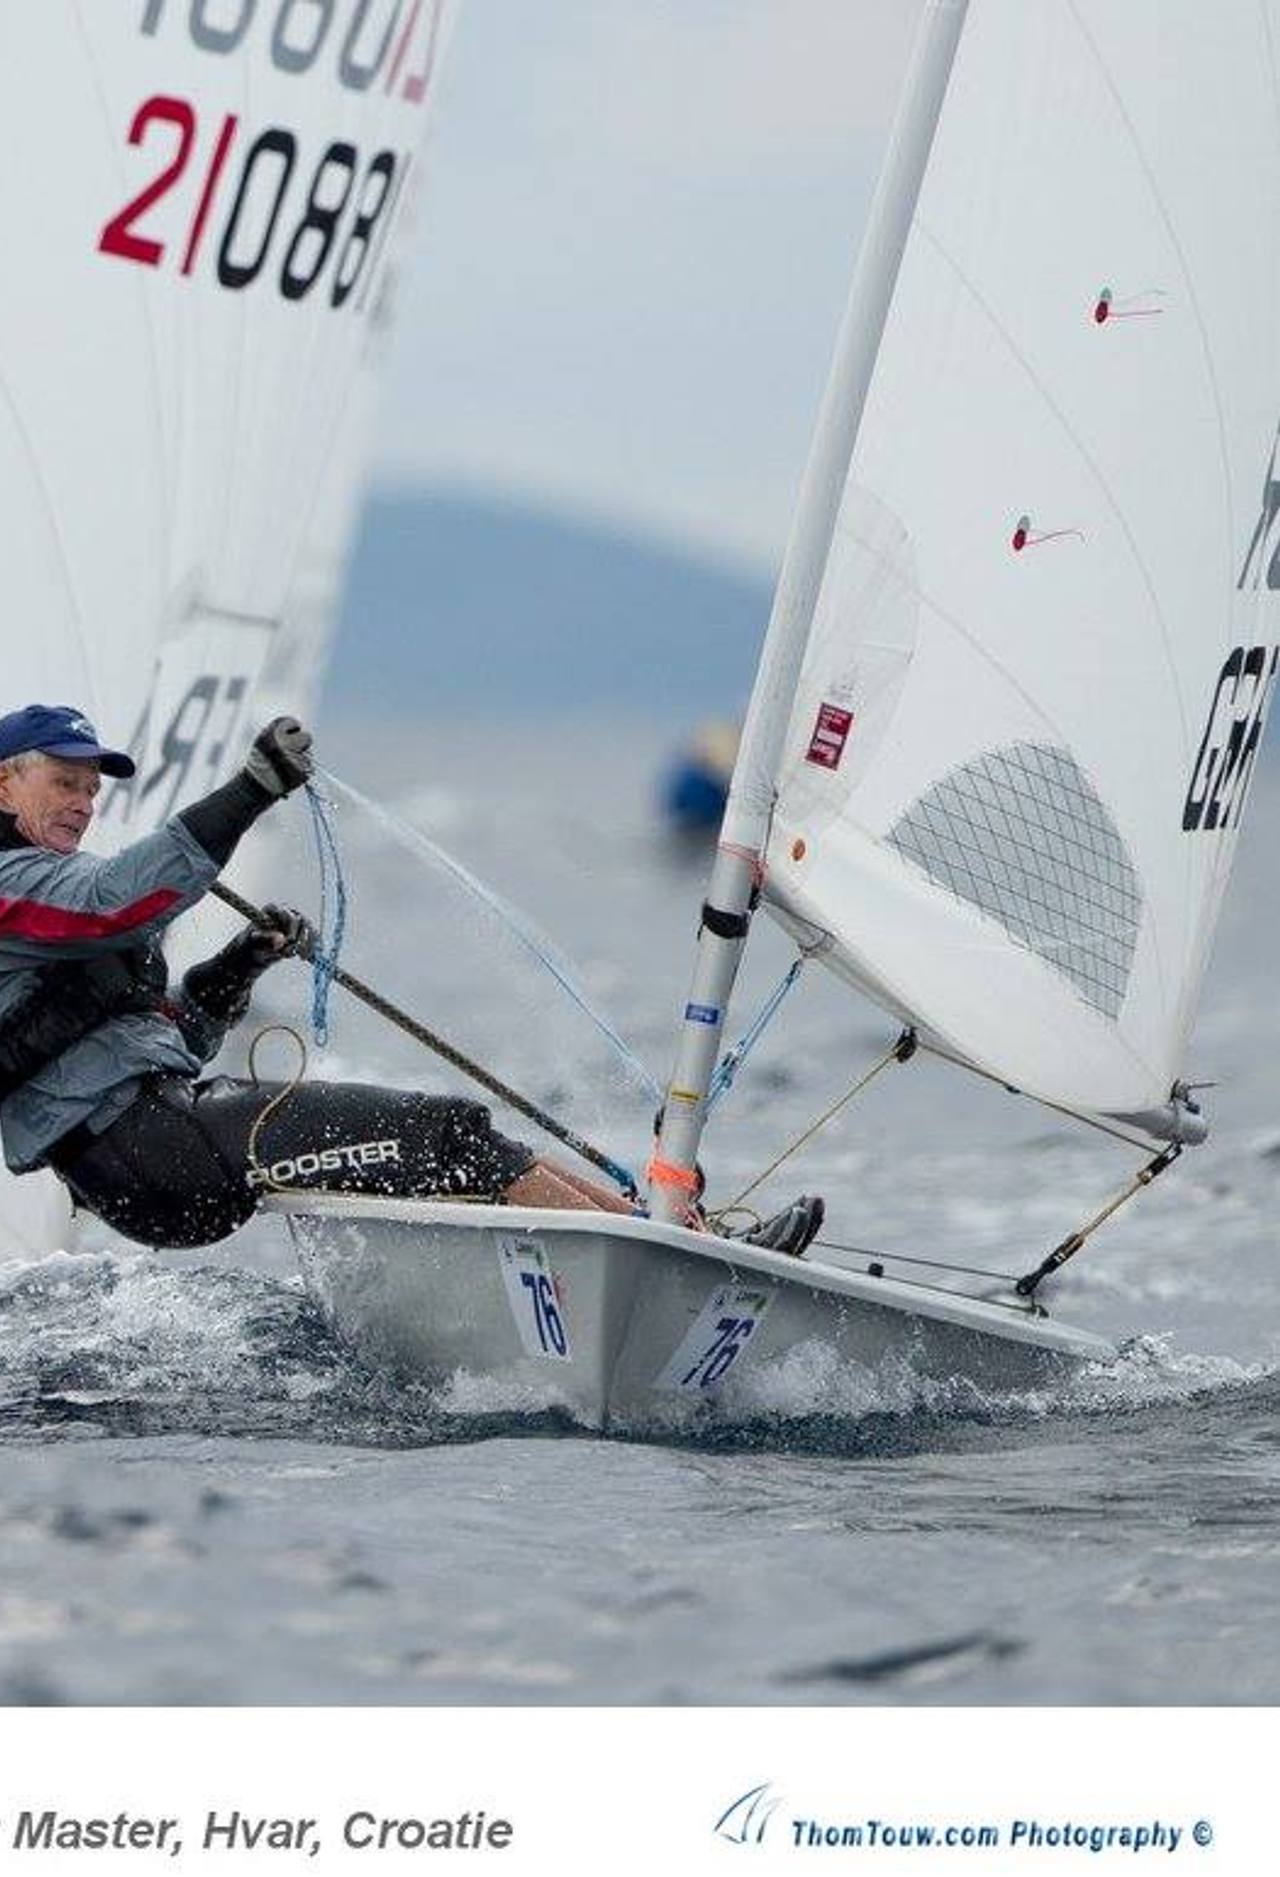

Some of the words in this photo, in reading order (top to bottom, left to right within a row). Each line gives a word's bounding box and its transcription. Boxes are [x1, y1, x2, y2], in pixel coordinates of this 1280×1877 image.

[245, 1138, 402, 1188] ROOSTER
[520, 1272, 567, 1357] 76
[681, 1317, 755, 1389] 76
